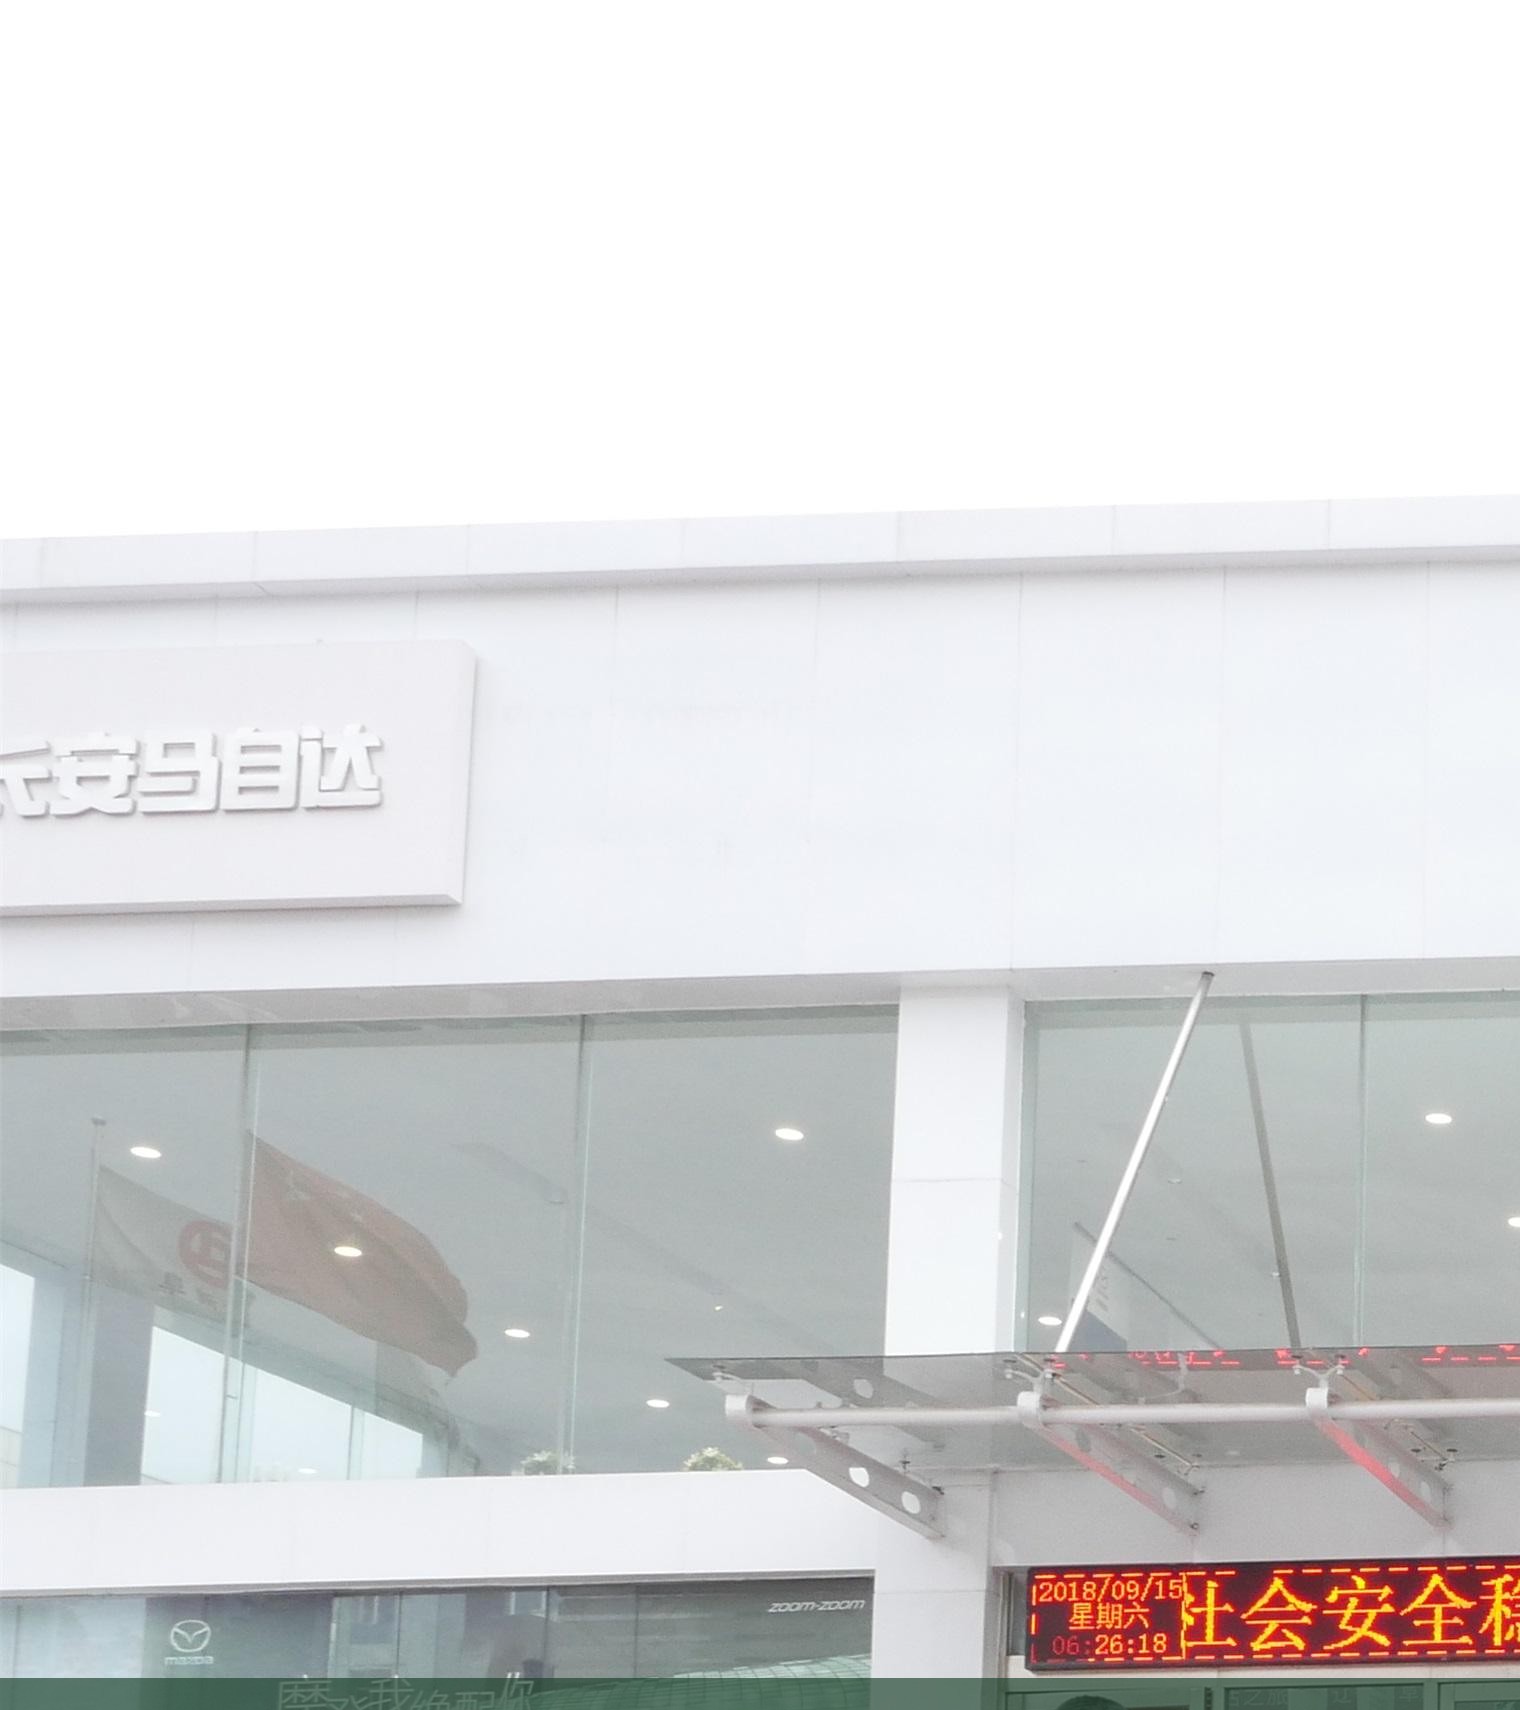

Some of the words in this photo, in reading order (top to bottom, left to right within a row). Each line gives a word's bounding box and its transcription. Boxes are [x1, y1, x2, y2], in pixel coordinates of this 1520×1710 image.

[1037, 1577, 1184, 1604] 2018/09/15
[1067, 1602, 1151, 1632] 星期六
[1051, 1632, 1168, 1657] 06:26:18
